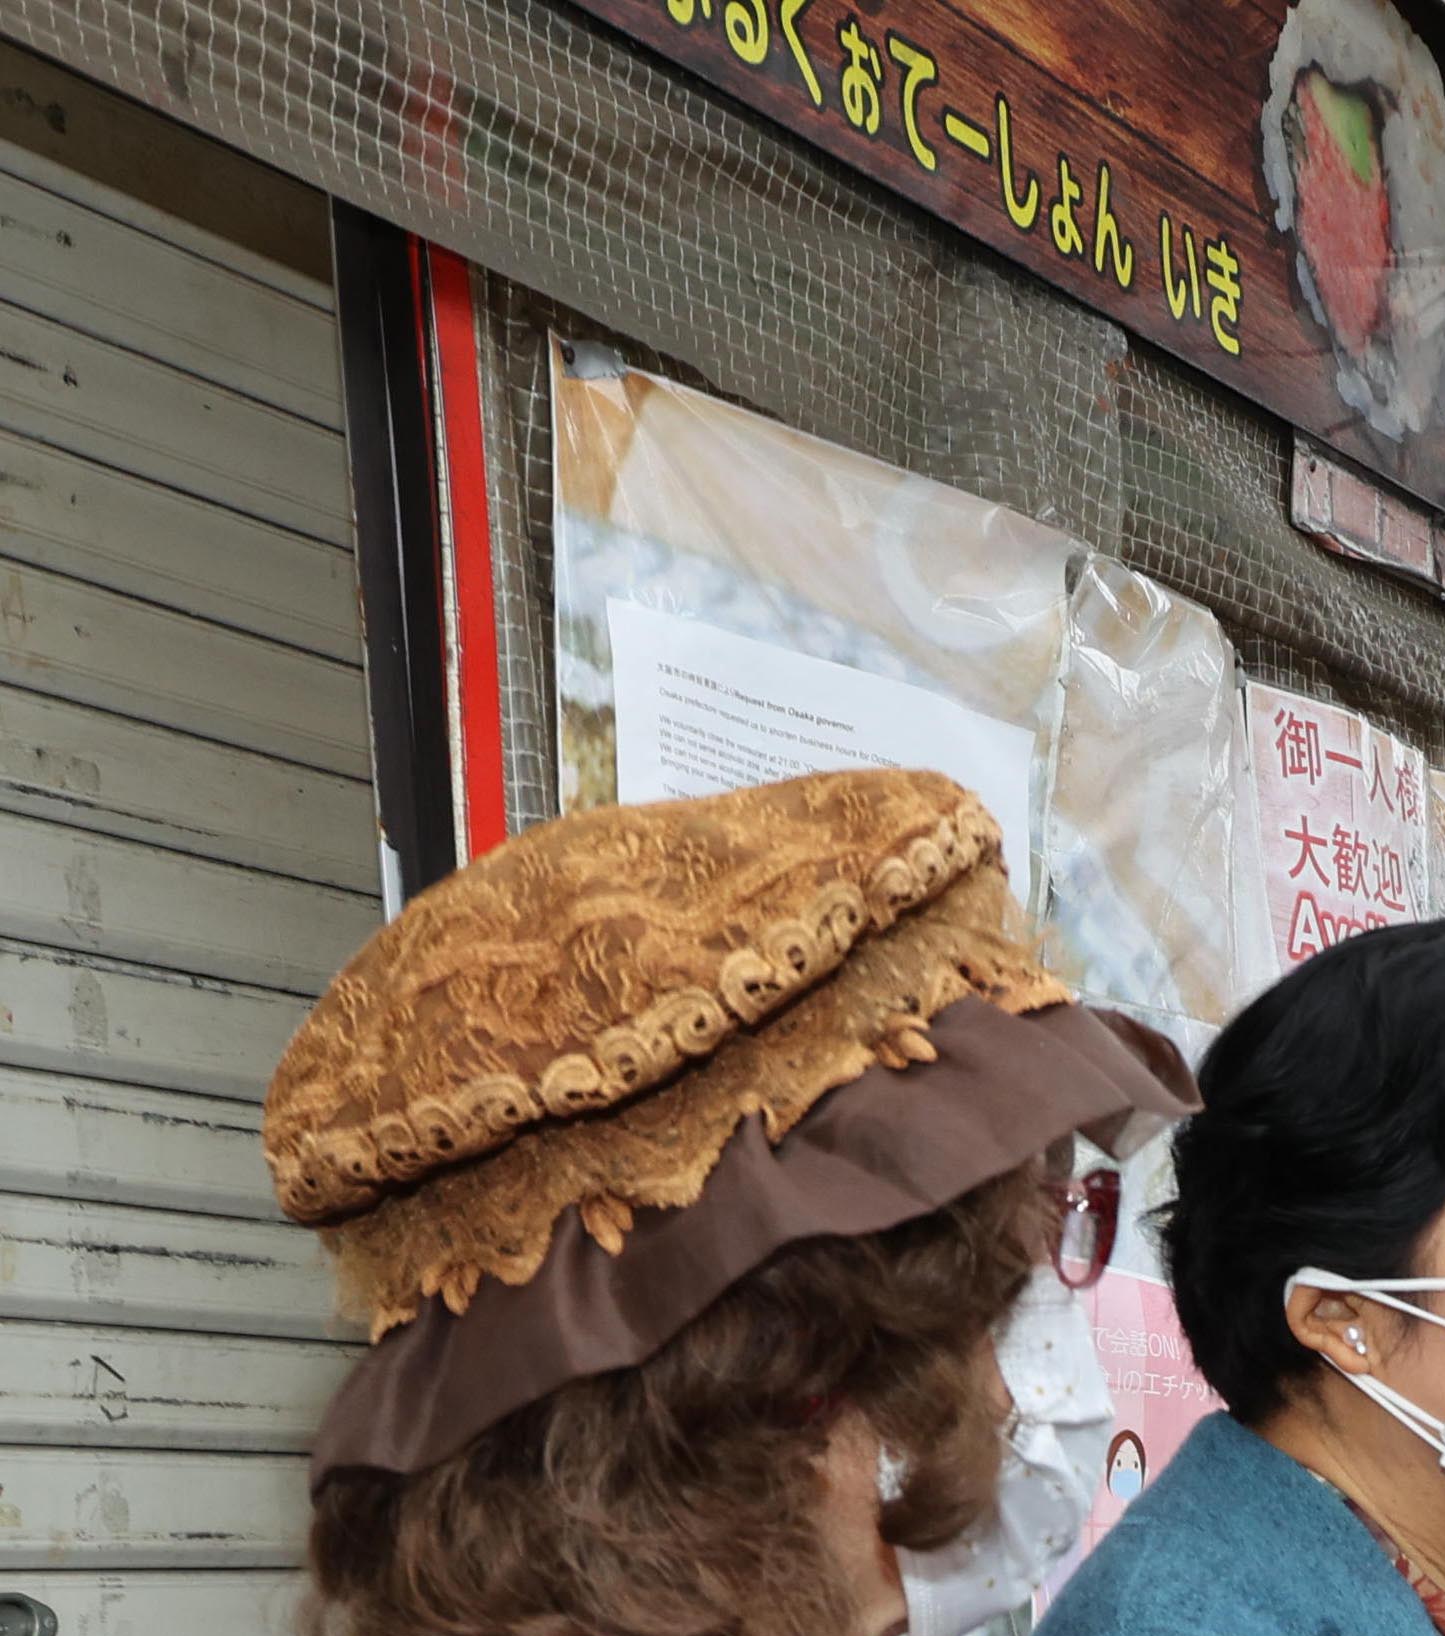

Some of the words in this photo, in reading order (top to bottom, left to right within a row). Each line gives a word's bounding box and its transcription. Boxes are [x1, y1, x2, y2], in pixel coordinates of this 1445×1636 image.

[667, 0, 1132, 287] るくおてーしょん
[1163, 217, 1240, 355] いき
[788, 707, 814, 722] Osaka
[1285, 815, 1406, 912] 大歓迎
